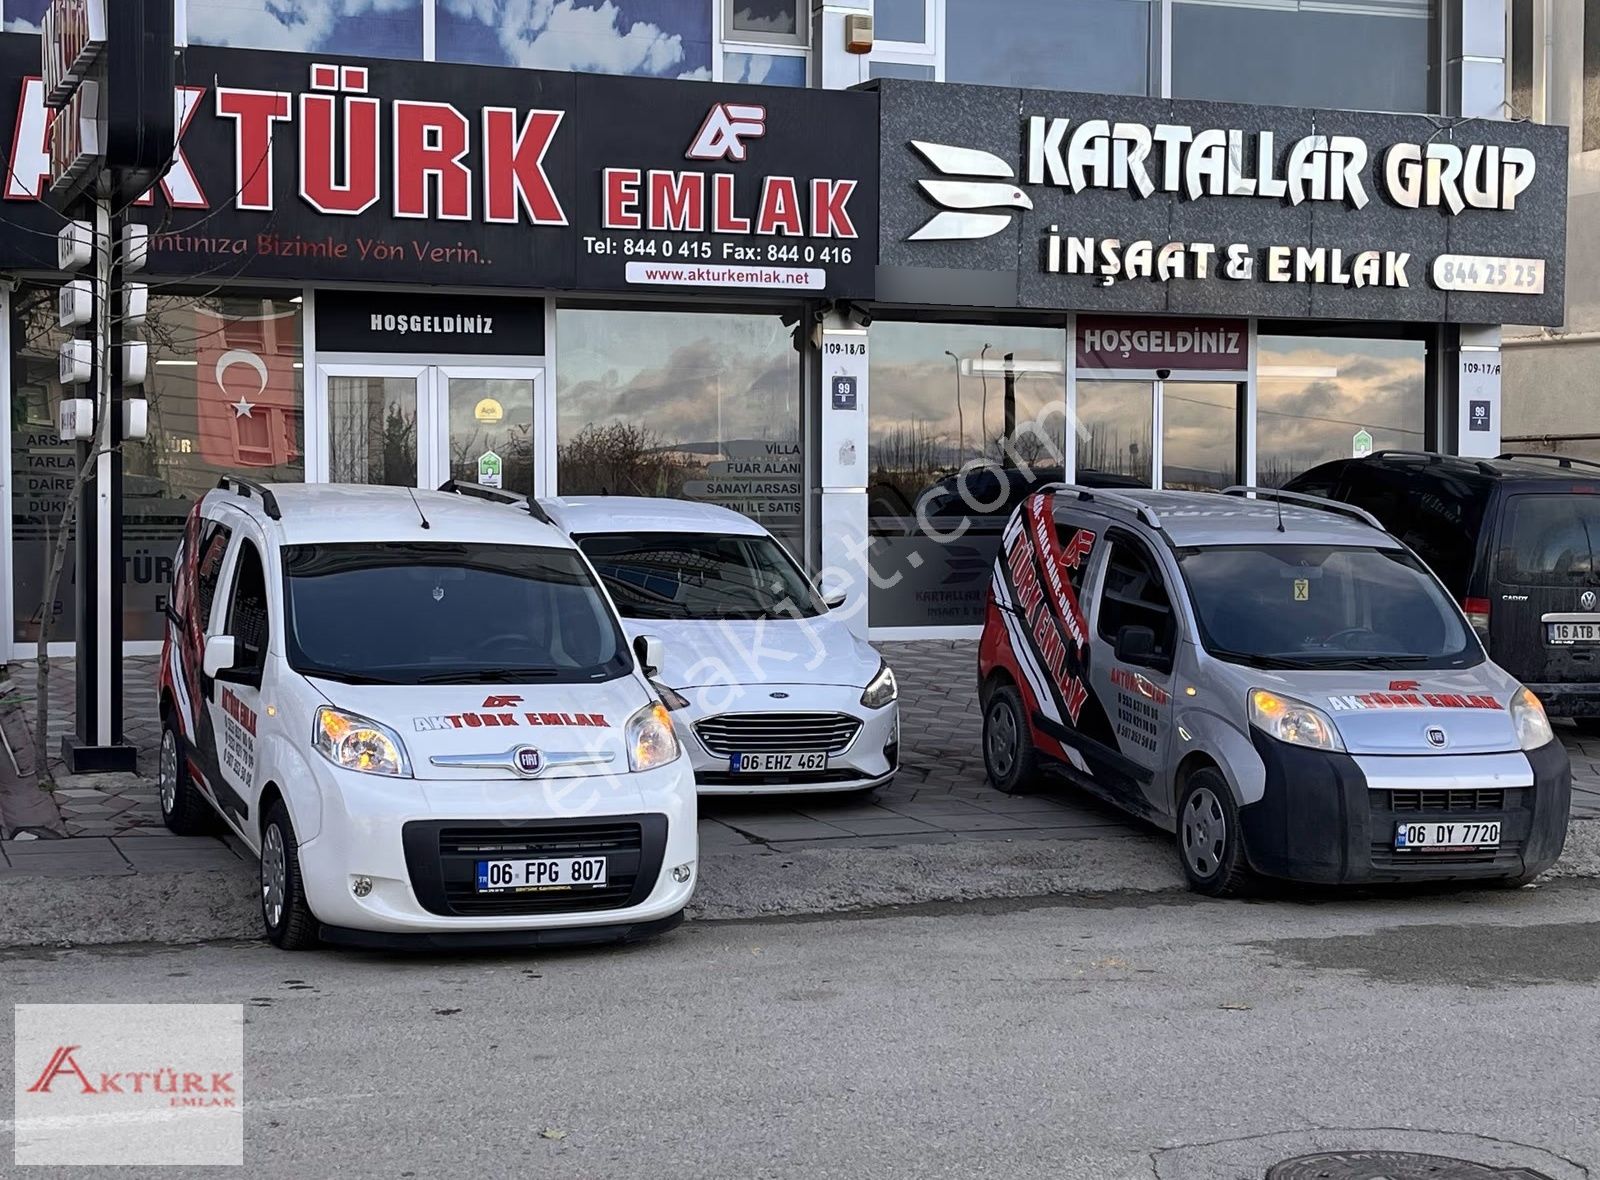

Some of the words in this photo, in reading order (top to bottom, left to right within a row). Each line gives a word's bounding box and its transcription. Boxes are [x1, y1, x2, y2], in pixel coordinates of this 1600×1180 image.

[1028, 115, 1370, 210] KARTALLAR
[1386, 142, 1537, 216] GRUP
[602, 167, 859, 239] EMLAK
[151, 235, 248, 255] ntınıza
[256, 235, 348, 258] Bizimle
[356, 238, 404, 260] Yön
[583, 236, 617, 254] Tel:
[623, 239, 657, 256] 844
[662, 241, 673, 257] 0
[678, 242, 712, 259] 415
[722, 243, 761, 261] Fax:
[767, 245, 799, 262] 844
[804, 246, 815, 262] 0
[819, 246, 852, 264] 416
[1047, 224, 1215, 286] İNŞAAT
[1226, 243, 1253, 279] &
[1268, 245, 1411, 289] EMLAK
[645, 268, 810, 285] www.akturkemlak.net
[1443, 262, 1479, 284] 844
[1485, 264, 1507, 287] 25
[1514, 265, 1536, 287] 25
[370, 314, 493, 335] HOŞGELDİNİZ
[824, 343, 866, 356] 109-18/B
[1084, 327, 1240, 359] HOŞGELDİNİZ
[838, 382, 850, 394] 99
[26, 434, 70, 447] ARSA
[765, 443, 800, 455] VİLLA
[26, 456, 76, 469] TARLA
[727, 462, 761, 474] FUAR
[764, 462, 800, 474] ALANI
[28, 475, 74, 490] DAİRE
[706, 481, 752, 494] SANAYİ
[755, 483, 800, 494] ARSASI
[768, 502, 801, 515] SATIŞ
[1556, 625, 1569, 638] 16
[1572, 625, 1594, 638] ATB
[1327, 692, 1424, 711] AKTÜRK
[1422, 693, 1505, 710] EMLAK
[413, 712, 520, 732] AKTÜRK
[523, 712, 612, 728] EMLAK
[520, 753, 539, 768] FIAT
[741, 754, 760, 770] 06
[764, 754, 793, 770] EHZ
[797, 754, 824, 769] 462
[1407, 825, 1427, 844] 06
[1436, 825, 1455, 844] DY
[1462, 824, 1498, 843] 7720
[490, 863, 513, 885] 06
[525, 861, 560, 884] FPG
[570, 859, 605, 882] 807
